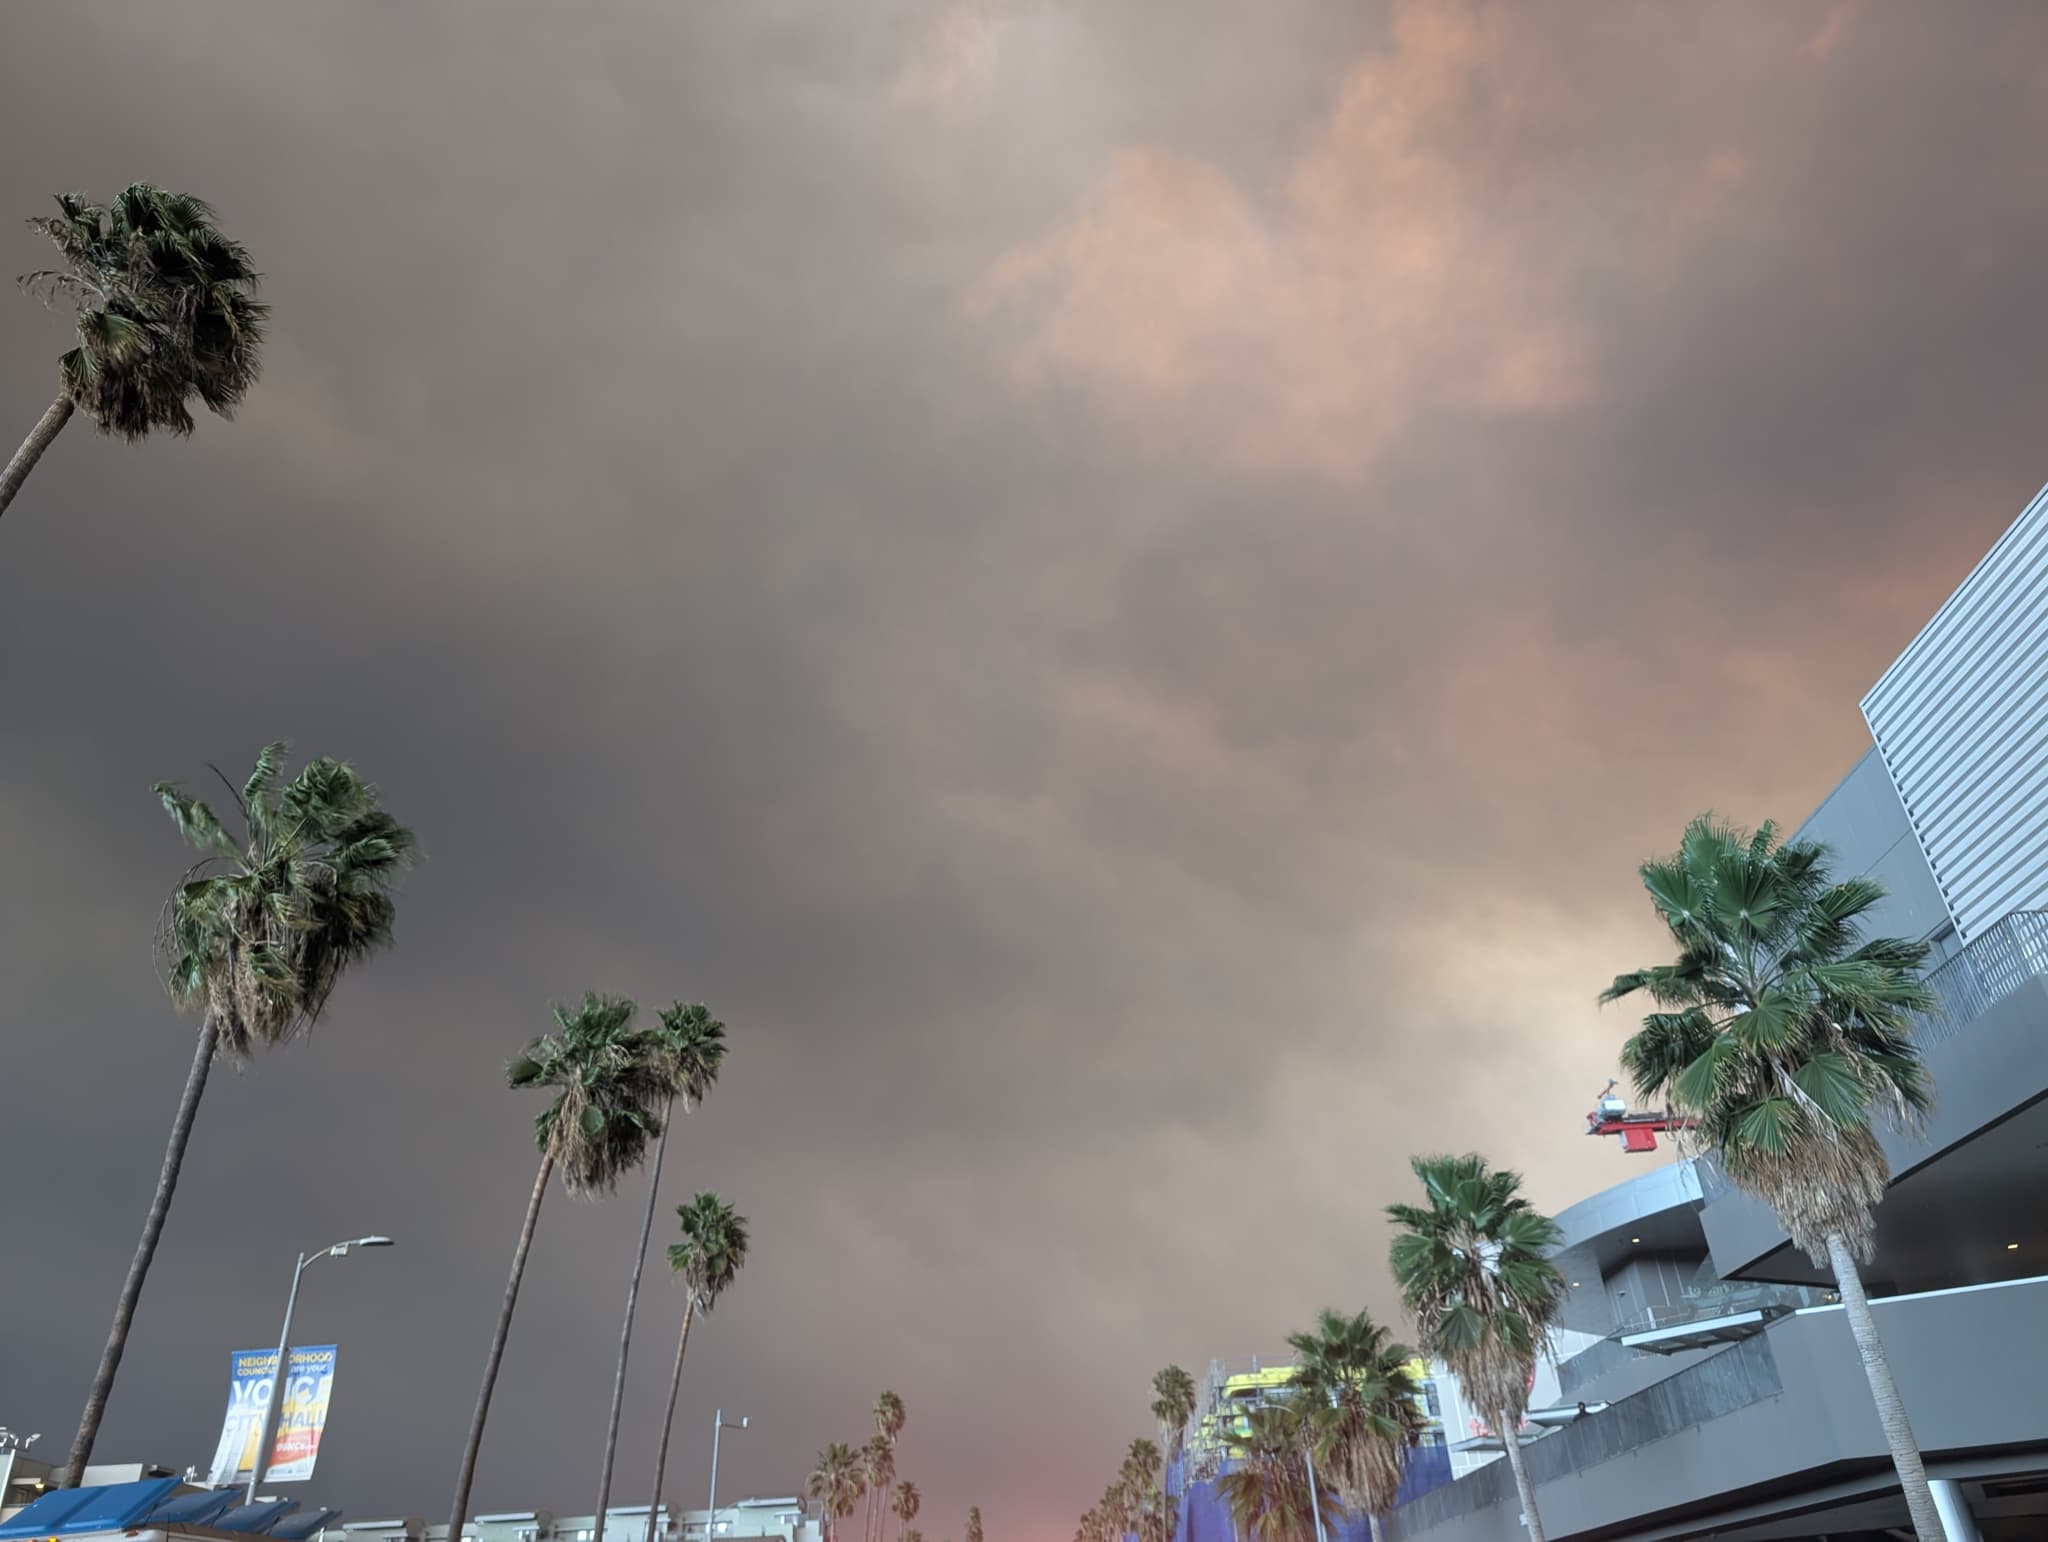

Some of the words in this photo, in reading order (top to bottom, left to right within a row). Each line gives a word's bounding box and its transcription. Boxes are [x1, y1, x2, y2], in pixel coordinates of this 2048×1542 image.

[306, 1364, 327, 1375] your
[232, 1377, 333, 1406] VOICE
[279, 1409, 326, 1428] HALL
